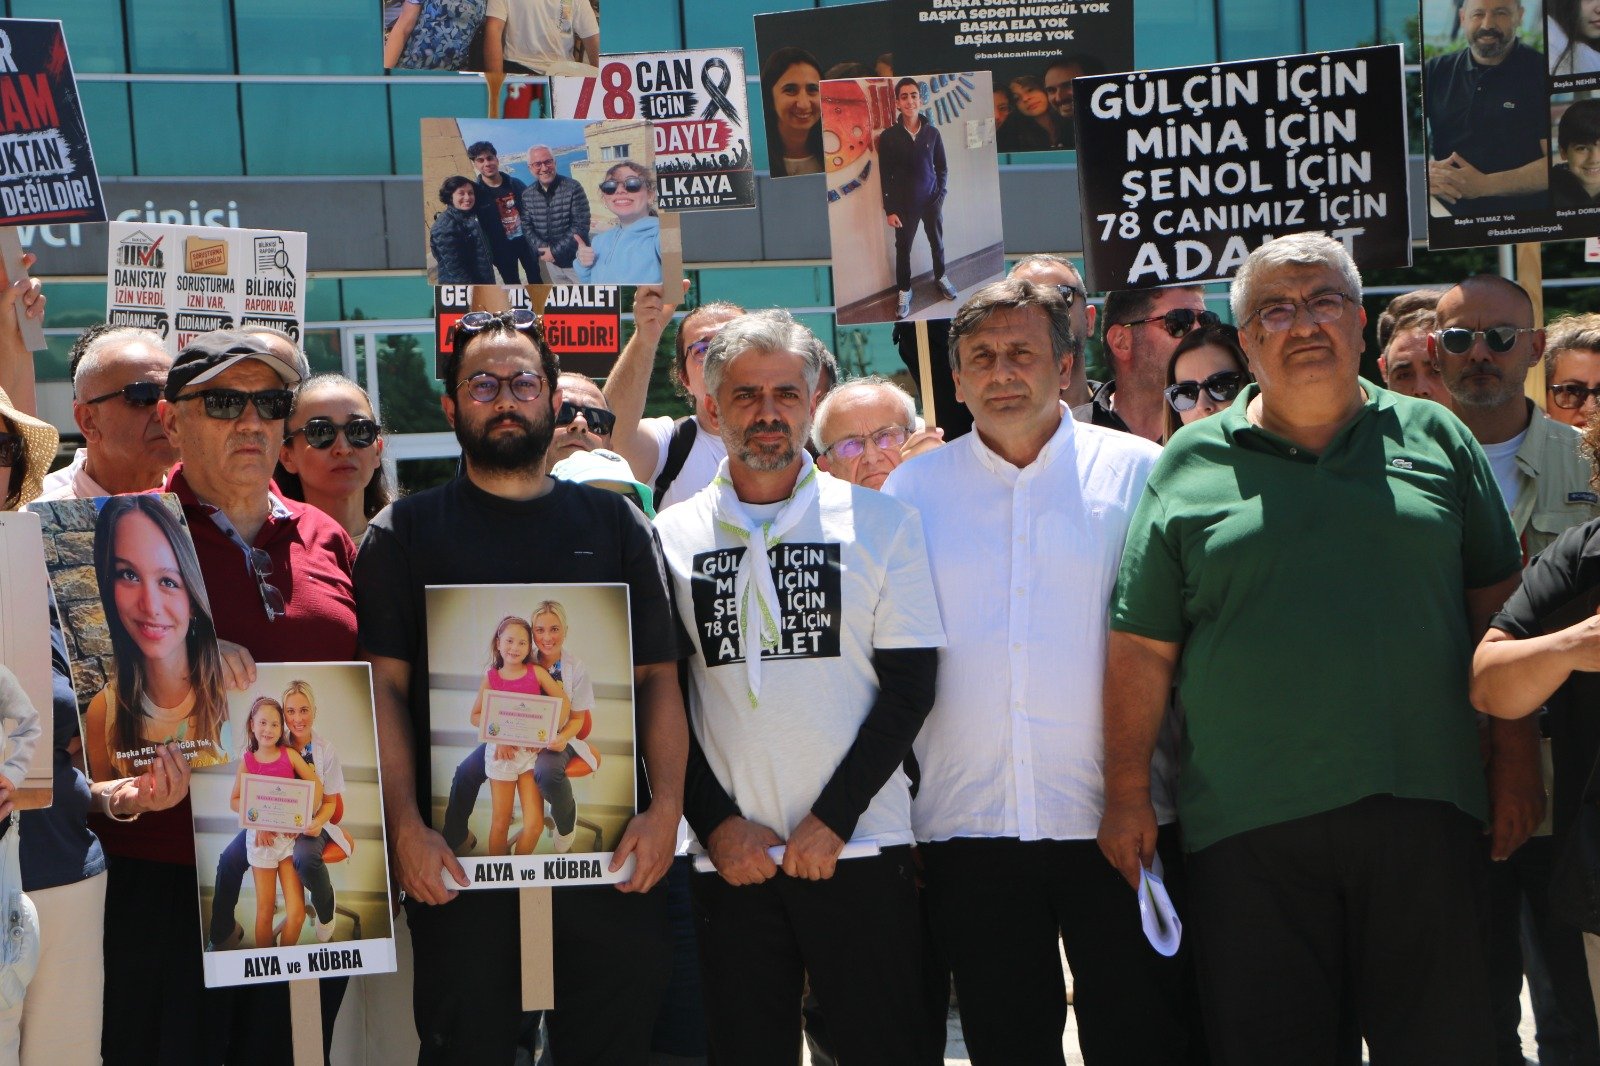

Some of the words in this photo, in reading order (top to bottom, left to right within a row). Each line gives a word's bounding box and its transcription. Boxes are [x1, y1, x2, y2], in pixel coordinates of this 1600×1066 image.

[919, 11, 967, 23] BAŞKA
[1019, 3, 1078, 17] NURGÜL
[1080, 2, 1110, 14] YOK
[960, 21, 1009, 34] BAŞKA
[1011, 19, 1037, 30] ELA
[1039, 17, 1068, 29] YOK
[954, 34, 1002, 47] BAŞKA
[1045, 30, 1074, 41] YOK
[974, 49, 1063, 61] @baskacanimizyok
[636, 58, 694, 92] CAN
[1090, 66, 1259, 121] GÜLÇİN
[1276, 55, 1368, 107] İÇİN
[650, 96, 685, 118] İÇİN
[1126, 118, 1249, 163] MİNA
[1265, 105, 1356, 153] İÇİN
[657, 174, 733, 197] LKAYA
[1121, 159, 1274, 209] ŞENOL
[1286, 147, 1372, 195] İÇİN
[3, 175, 94, 217] DEĞİLDİR!
[1096, 211, 1141, 242] 78
[1153, 199, 1306, 236] CANIMIZ
[1319, 189, 1387, 227] İÇİN
[1475, 215, 1502, 224] YILMAZ
[1503, 214, 1516, 222] Yok
[1487, 224, 1563, 237] @baskacanimizyok
[114, 269, 166, 290] DANIŞTAY
[177, 275, 235, 296] SORUŞTURMA
[246, 276, 297, 300] BİLİRKİŞİ
[115, 289, 134, 304] İZİN
[187, 292, 204, 308] İZNİ
[245, 298, 277, 312] RAPORU
[544, 286, 617, 307] ADALET
[113, 311, 157, 328] İDDİANAME
[178, 314, 222, 331] İDDİANAME
[783, 545, 825, 570] İÇİN
[778, 569, 819, 592] İÇİN
[787, 589, 826, 613] İÇİN
[704, 620, 723, 638] 78
[802, 610, 831, 631] İÇİN
[116, 750, 140, 759] Başka
[474, 863, 514, 882] ALYA
[520, 869, 536, 881] ve
[544, 858, 602, 879] KÜBRA
[244, 955, 281, 978] ALYA
[286, 961, 301, 974] ve
[308, 948, 363, 972] KÜBRA
